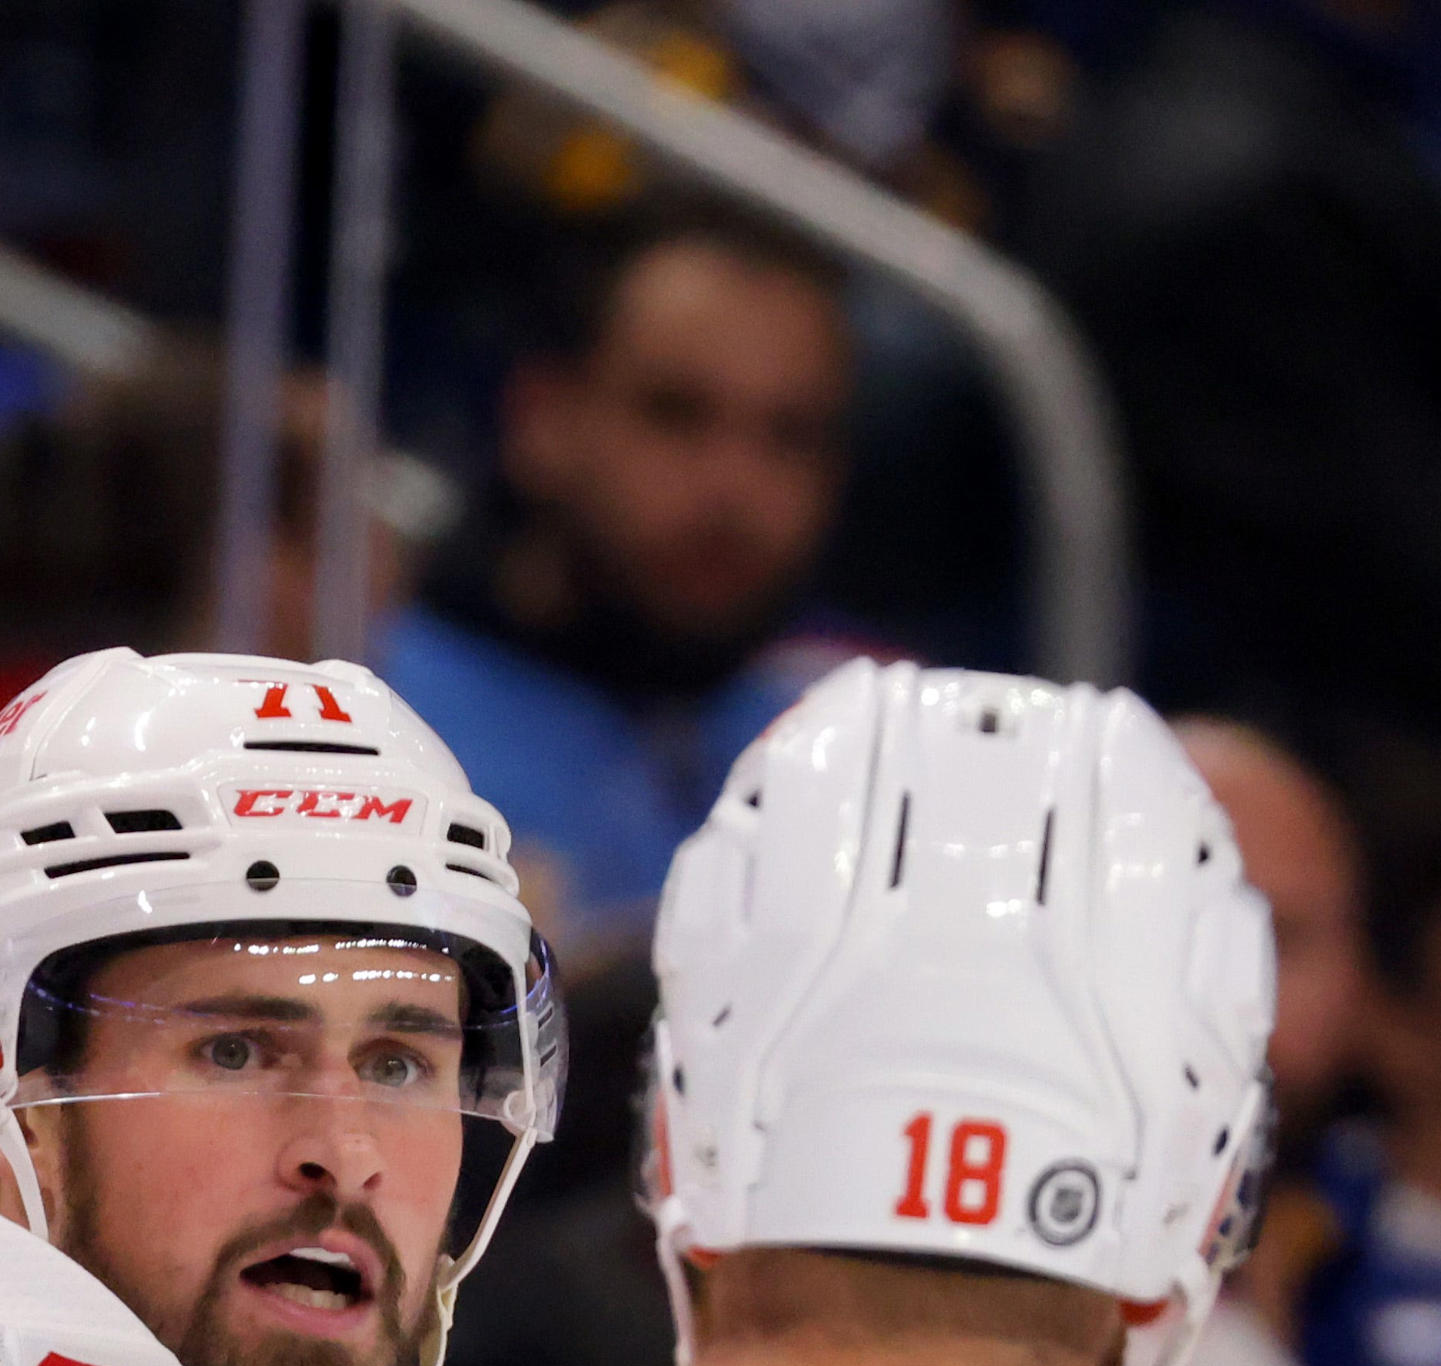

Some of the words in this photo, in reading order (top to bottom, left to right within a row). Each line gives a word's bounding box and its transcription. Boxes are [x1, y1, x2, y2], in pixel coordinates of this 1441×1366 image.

[236, 679, 353, 723] 71
[234, 789, 414, 823] CCM
[893, 1109, 1008, 1226] 18
